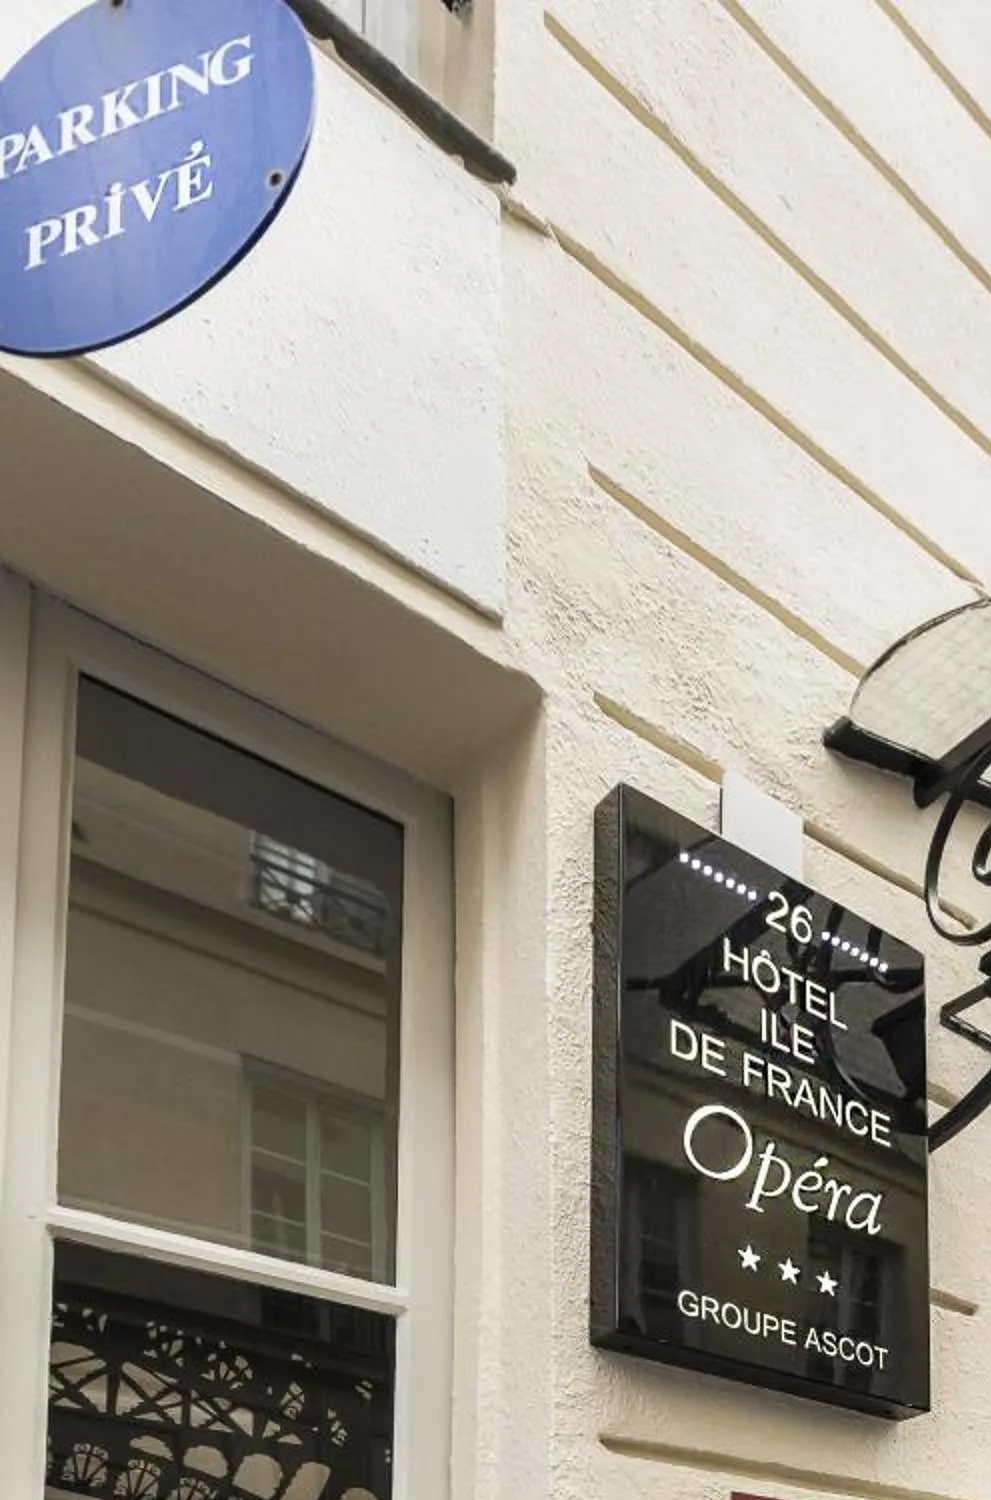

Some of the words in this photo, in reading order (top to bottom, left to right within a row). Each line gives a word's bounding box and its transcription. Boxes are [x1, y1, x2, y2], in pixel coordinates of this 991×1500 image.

[0, 36, 255, 180] PARKING
[765, 890, 813, 944] 26
[722, 937, 848, 1030] HÔTEL
[669, 1017, 726, 1078] DE
[742, 1052, 892, 1148] FRANCE
[760, 1007, 816, 1065] ILE
[683, 1103, 884, 1236] Opéra
[677, 1289, 798, 1346] GROUPE
[804, 1326, 890, 1370] ASCOT
